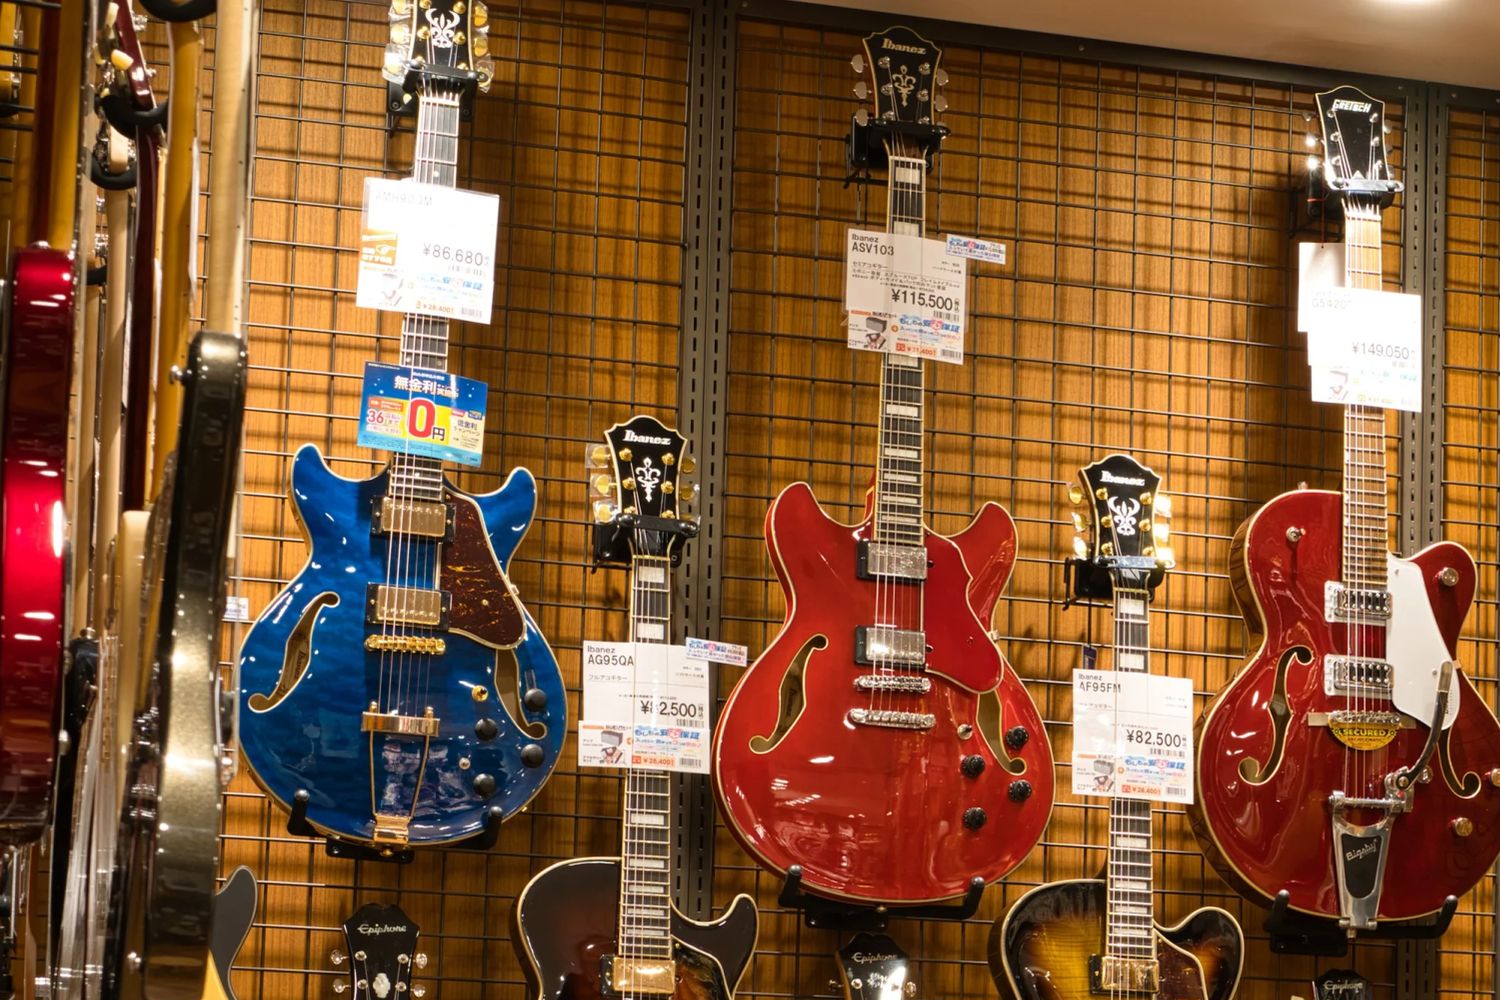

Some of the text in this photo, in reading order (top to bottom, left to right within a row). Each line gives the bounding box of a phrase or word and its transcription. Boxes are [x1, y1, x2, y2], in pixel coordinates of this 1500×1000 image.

[881, 38, 927, 55] Ibanez
[1332, 99, 1371, 113] GRETSCH
[852, 233, 879, 243] Ibanez
[423, 242, 483, 266] ¥86,680
[851, 243, 894, 256] ASV103
[891, 289, 953, 311] ¥115,500
[367, 409, 384, 425] 36
[622, 430, 671, 445] Ibanez
[1100, 470, 1145, 486] Ibanez
[587, 645, 615, 654] Ibanez
[587, 655, 634, 666] AG95QA
[1079, 681, 1121, 693] AF95FM
[1126, 729, 1181, 748] ¥82,500
[1343, 728, 1387, 738] SECURED
[357, 923, 407, 935] Epiphone
[852, 951, 897, 964] Epiphone
